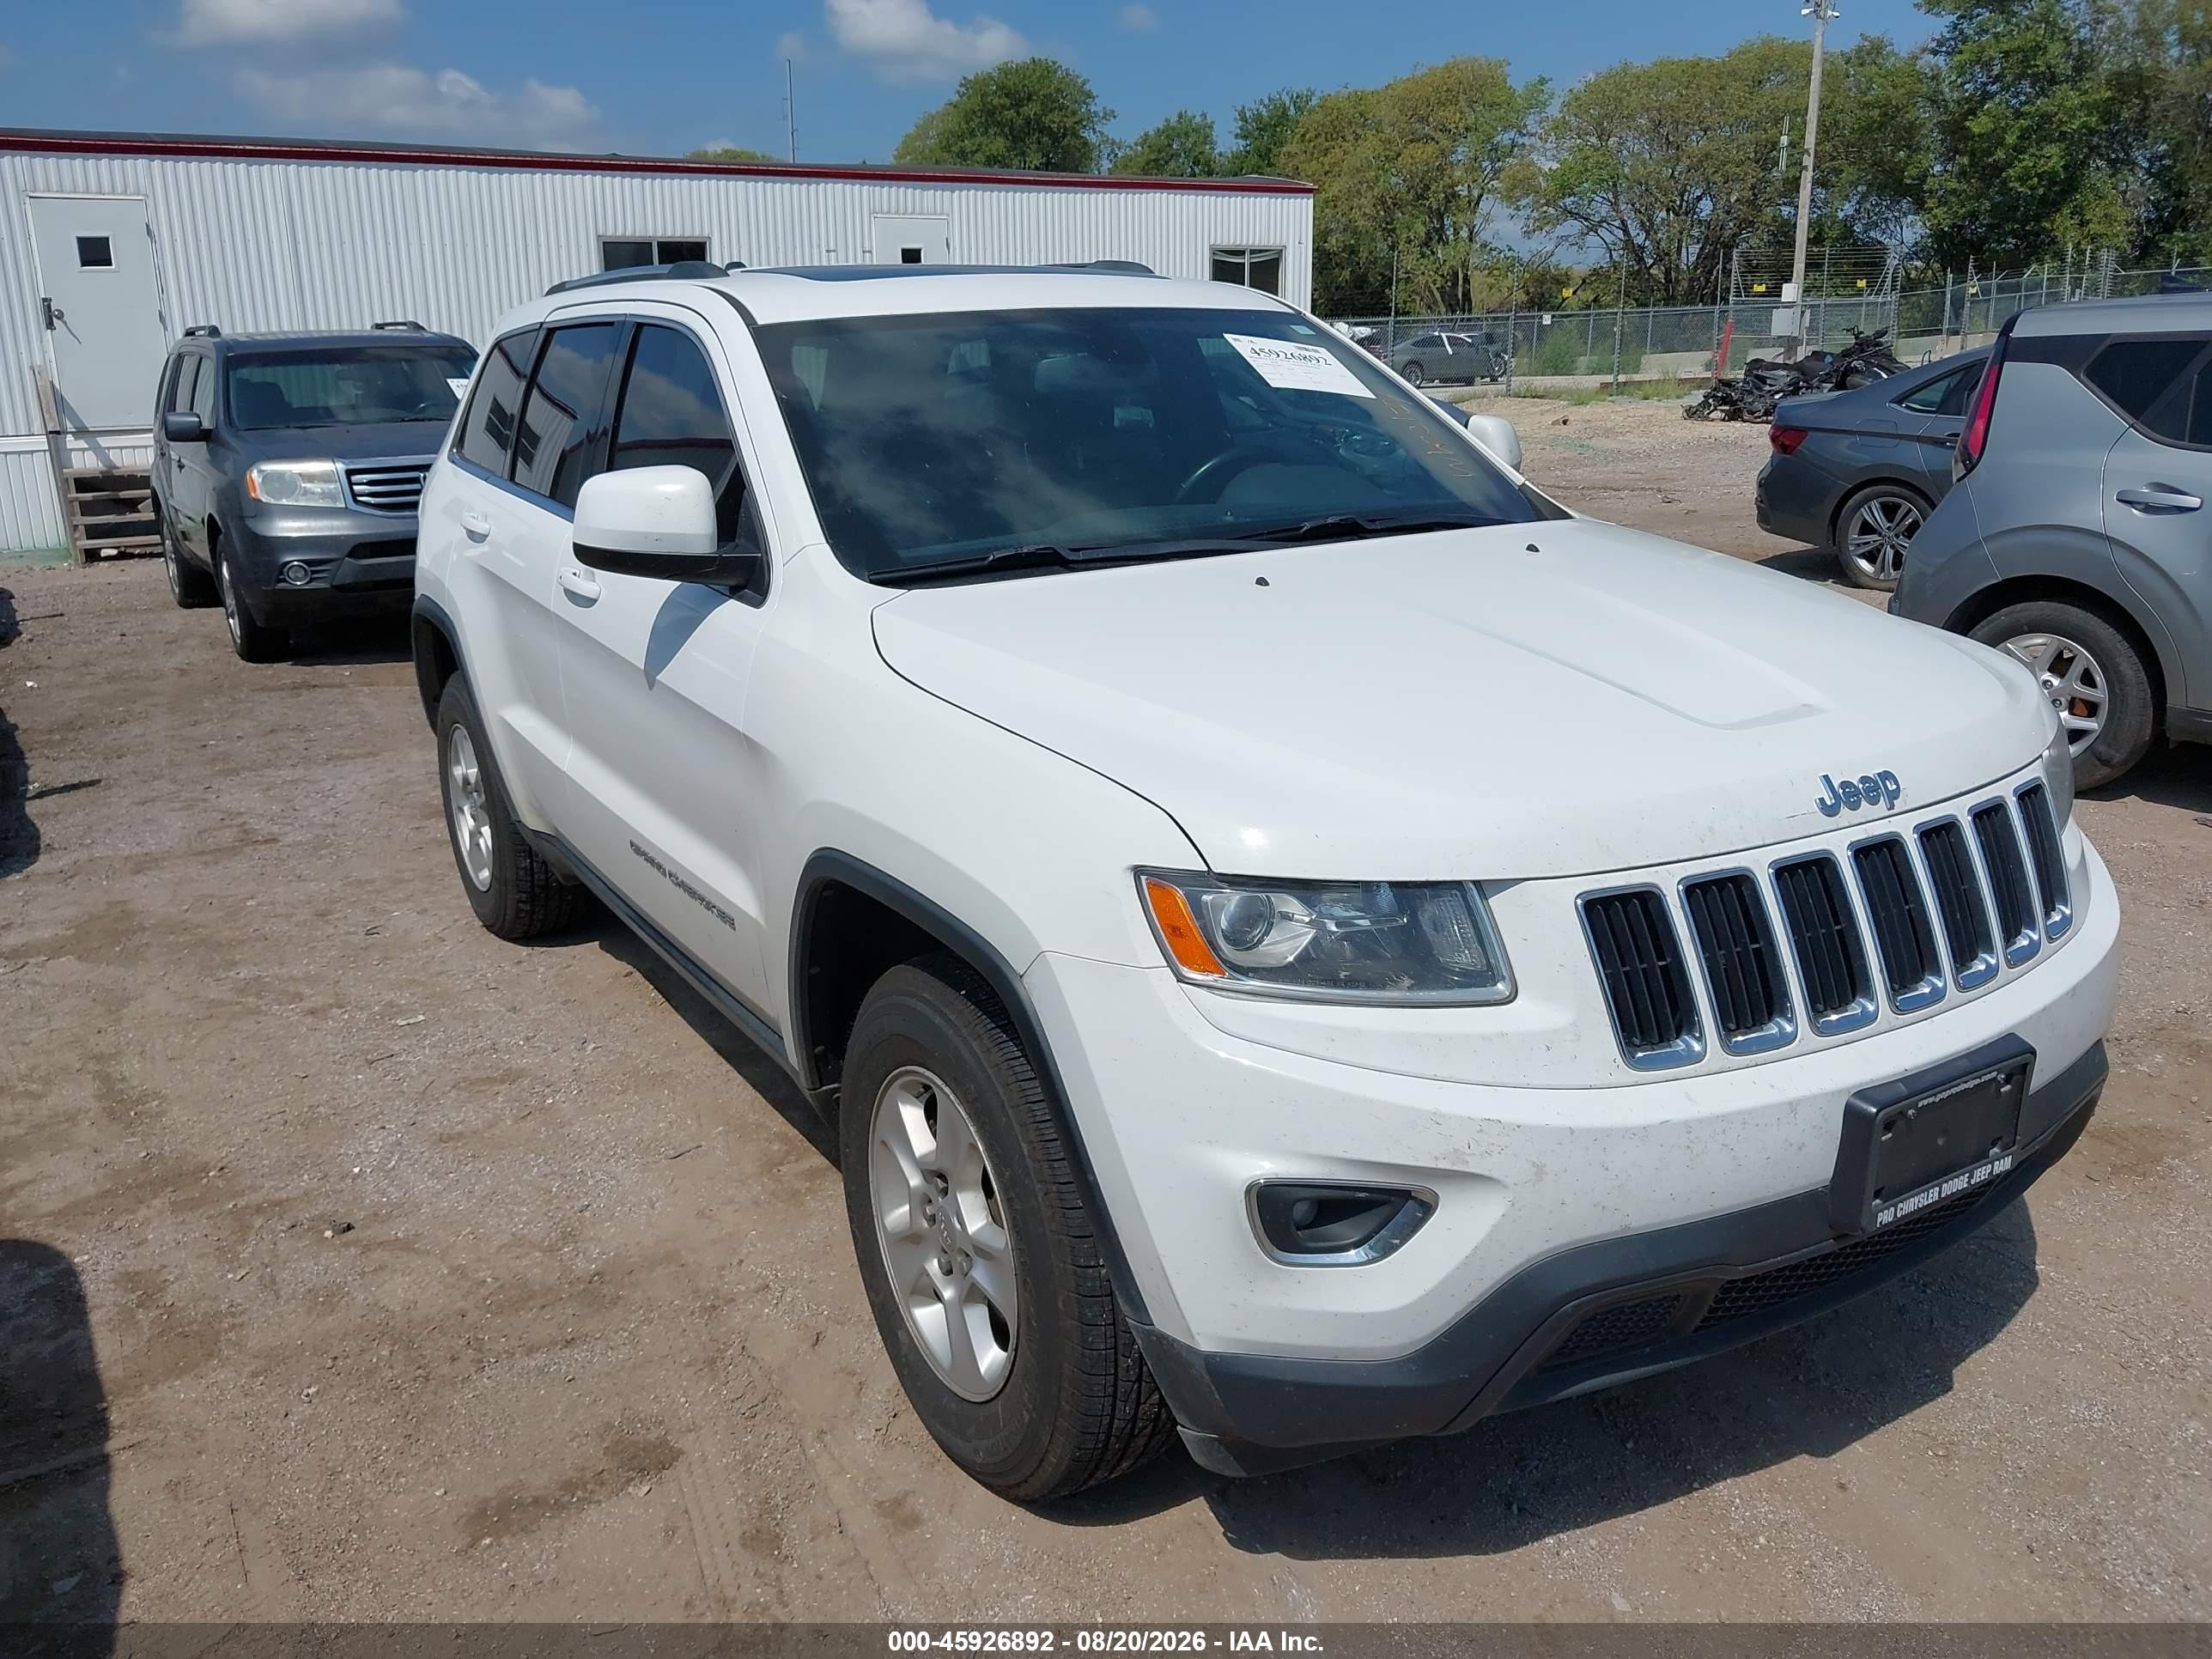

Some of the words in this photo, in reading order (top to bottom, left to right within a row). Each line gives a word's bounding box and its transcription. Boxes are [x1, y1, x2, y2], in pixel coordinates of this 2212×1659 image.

[1249, 346, 1333, 366] 45926892
[1814, 769, 1901, 818] Jeep
[1876, 1206, 1894, 1228] PRO
[1896, 1186, 1940, 1218] CHRYSLER
[1941, 1171, 1969, 1198] DODGE
[1971, 1163, 1992, 1186] JEEP
[1993, 1154, 2013, 1175] RAM
